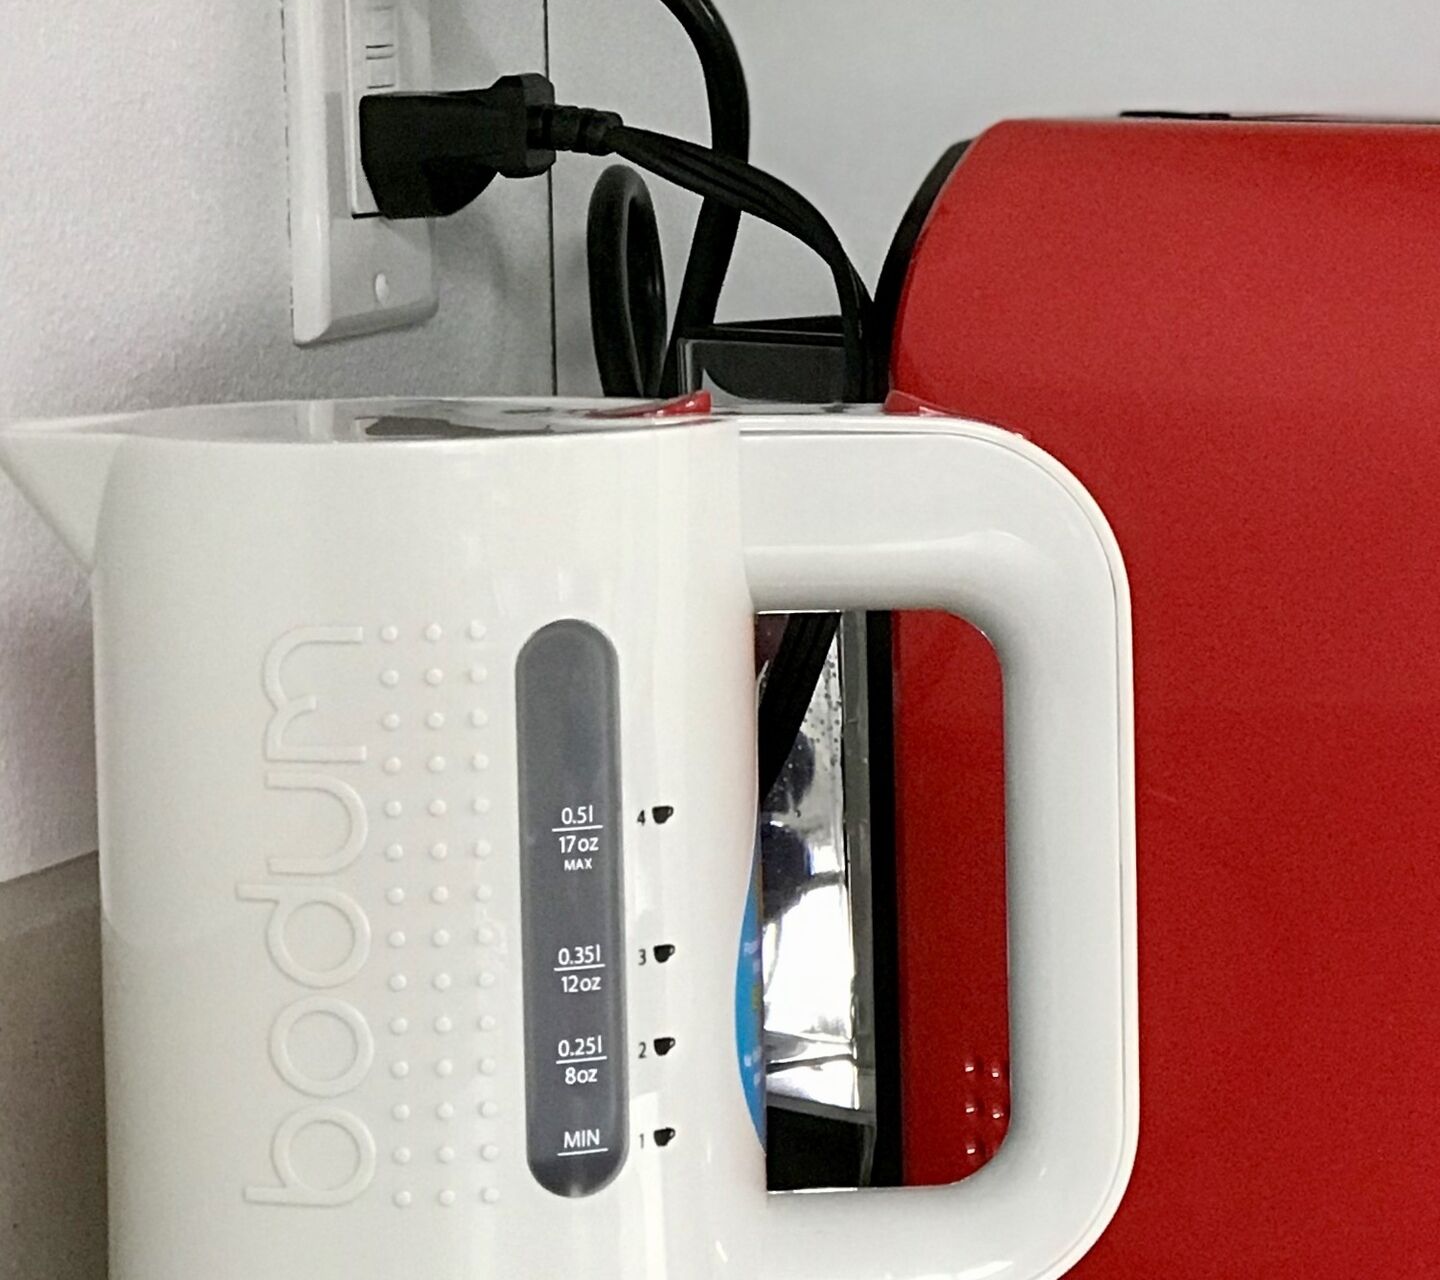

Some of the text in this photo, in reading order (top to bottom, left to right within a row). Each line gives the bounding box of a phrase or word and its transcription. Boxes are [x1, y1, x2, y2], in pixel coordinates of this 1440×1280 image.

[636, 809, 647, 827] 4
[564, 857, 593, 871] MAX
[234, 624, 376, 1208] bodum
[638, 948, 647, 967] 3
[560, 974, 602, 993] 12oz
[637, 1041, 647, 1060] 2
[564, 1066, 598, 1085] 8oz
[563, 1128, 601, 1149] MIN
